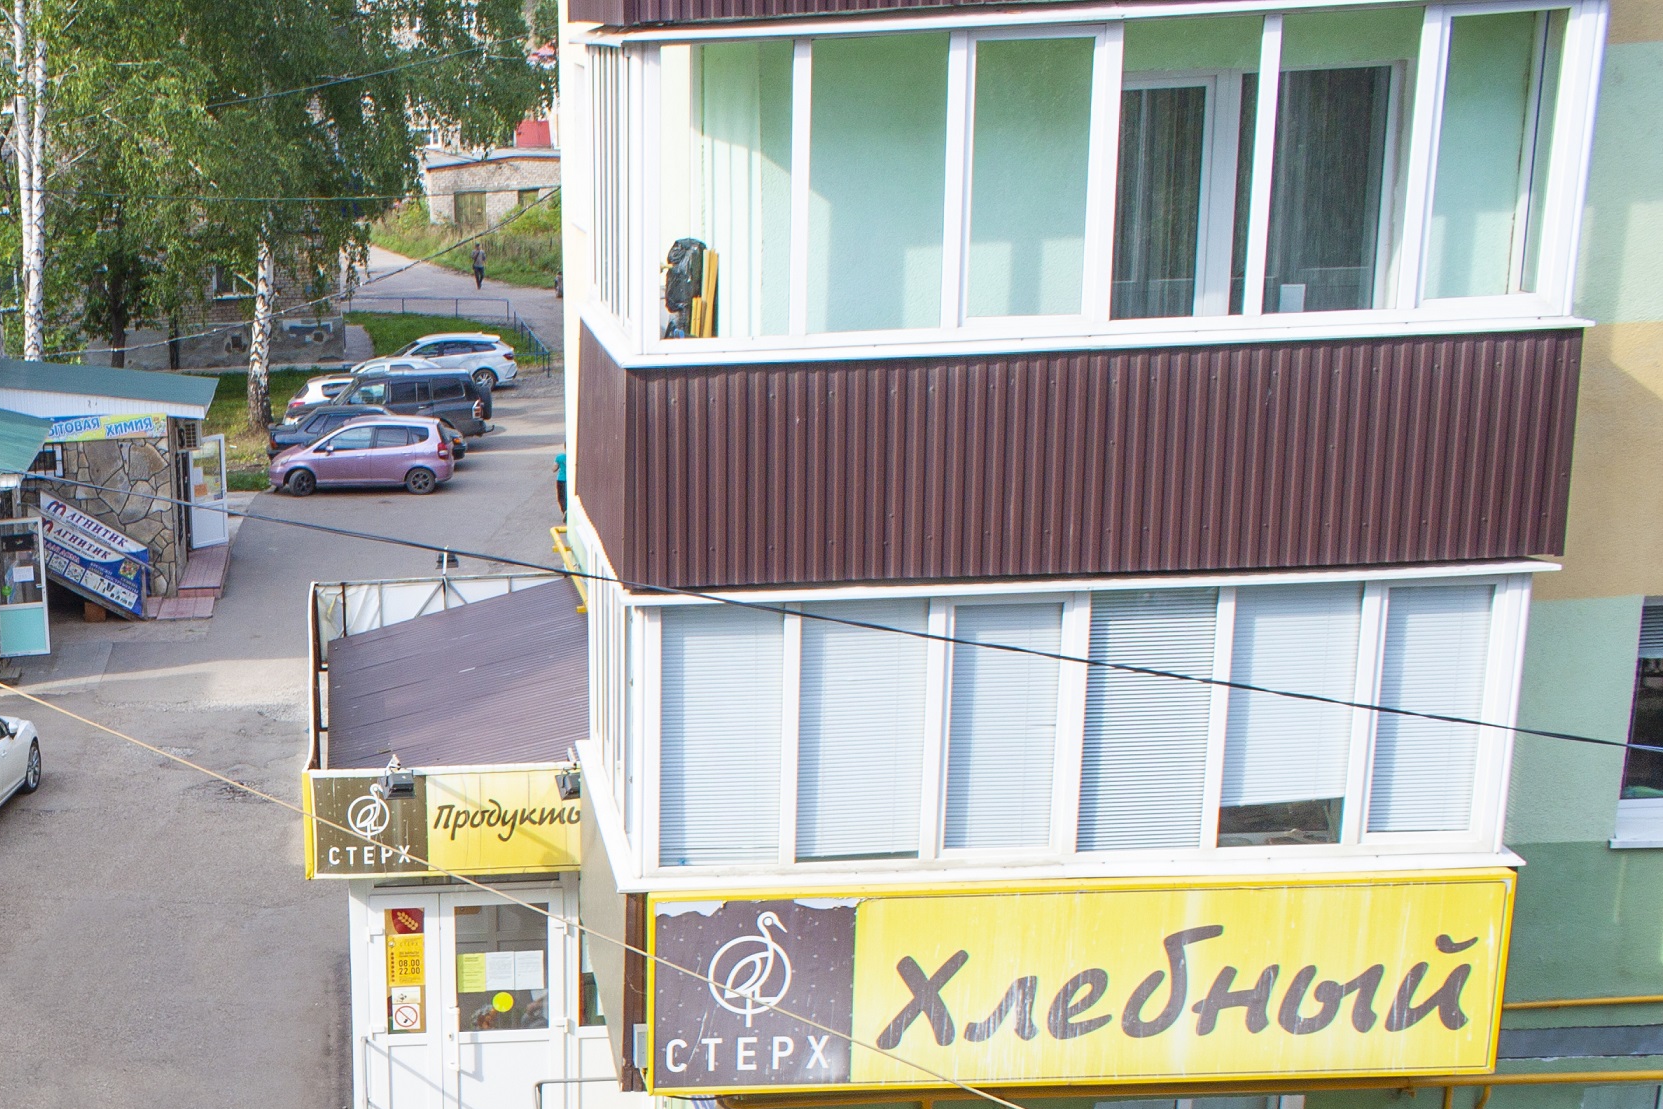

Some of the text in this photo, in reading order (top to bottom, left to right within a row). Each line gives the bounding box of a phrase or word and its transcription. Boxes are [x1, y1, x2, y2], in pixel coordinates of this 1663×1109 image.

[48, 416, 154, 437] ЫТОВАЯ ХИМИЯ
[328, 845, 412, 866] СТЕРХ
[398, 959, 421, 967] 08.00
[398, 967, 421, 976] 22.00
[877, 923, 1479, 1052] Хлебный
[664, 1034, 832, 1074] СТЕРХ
